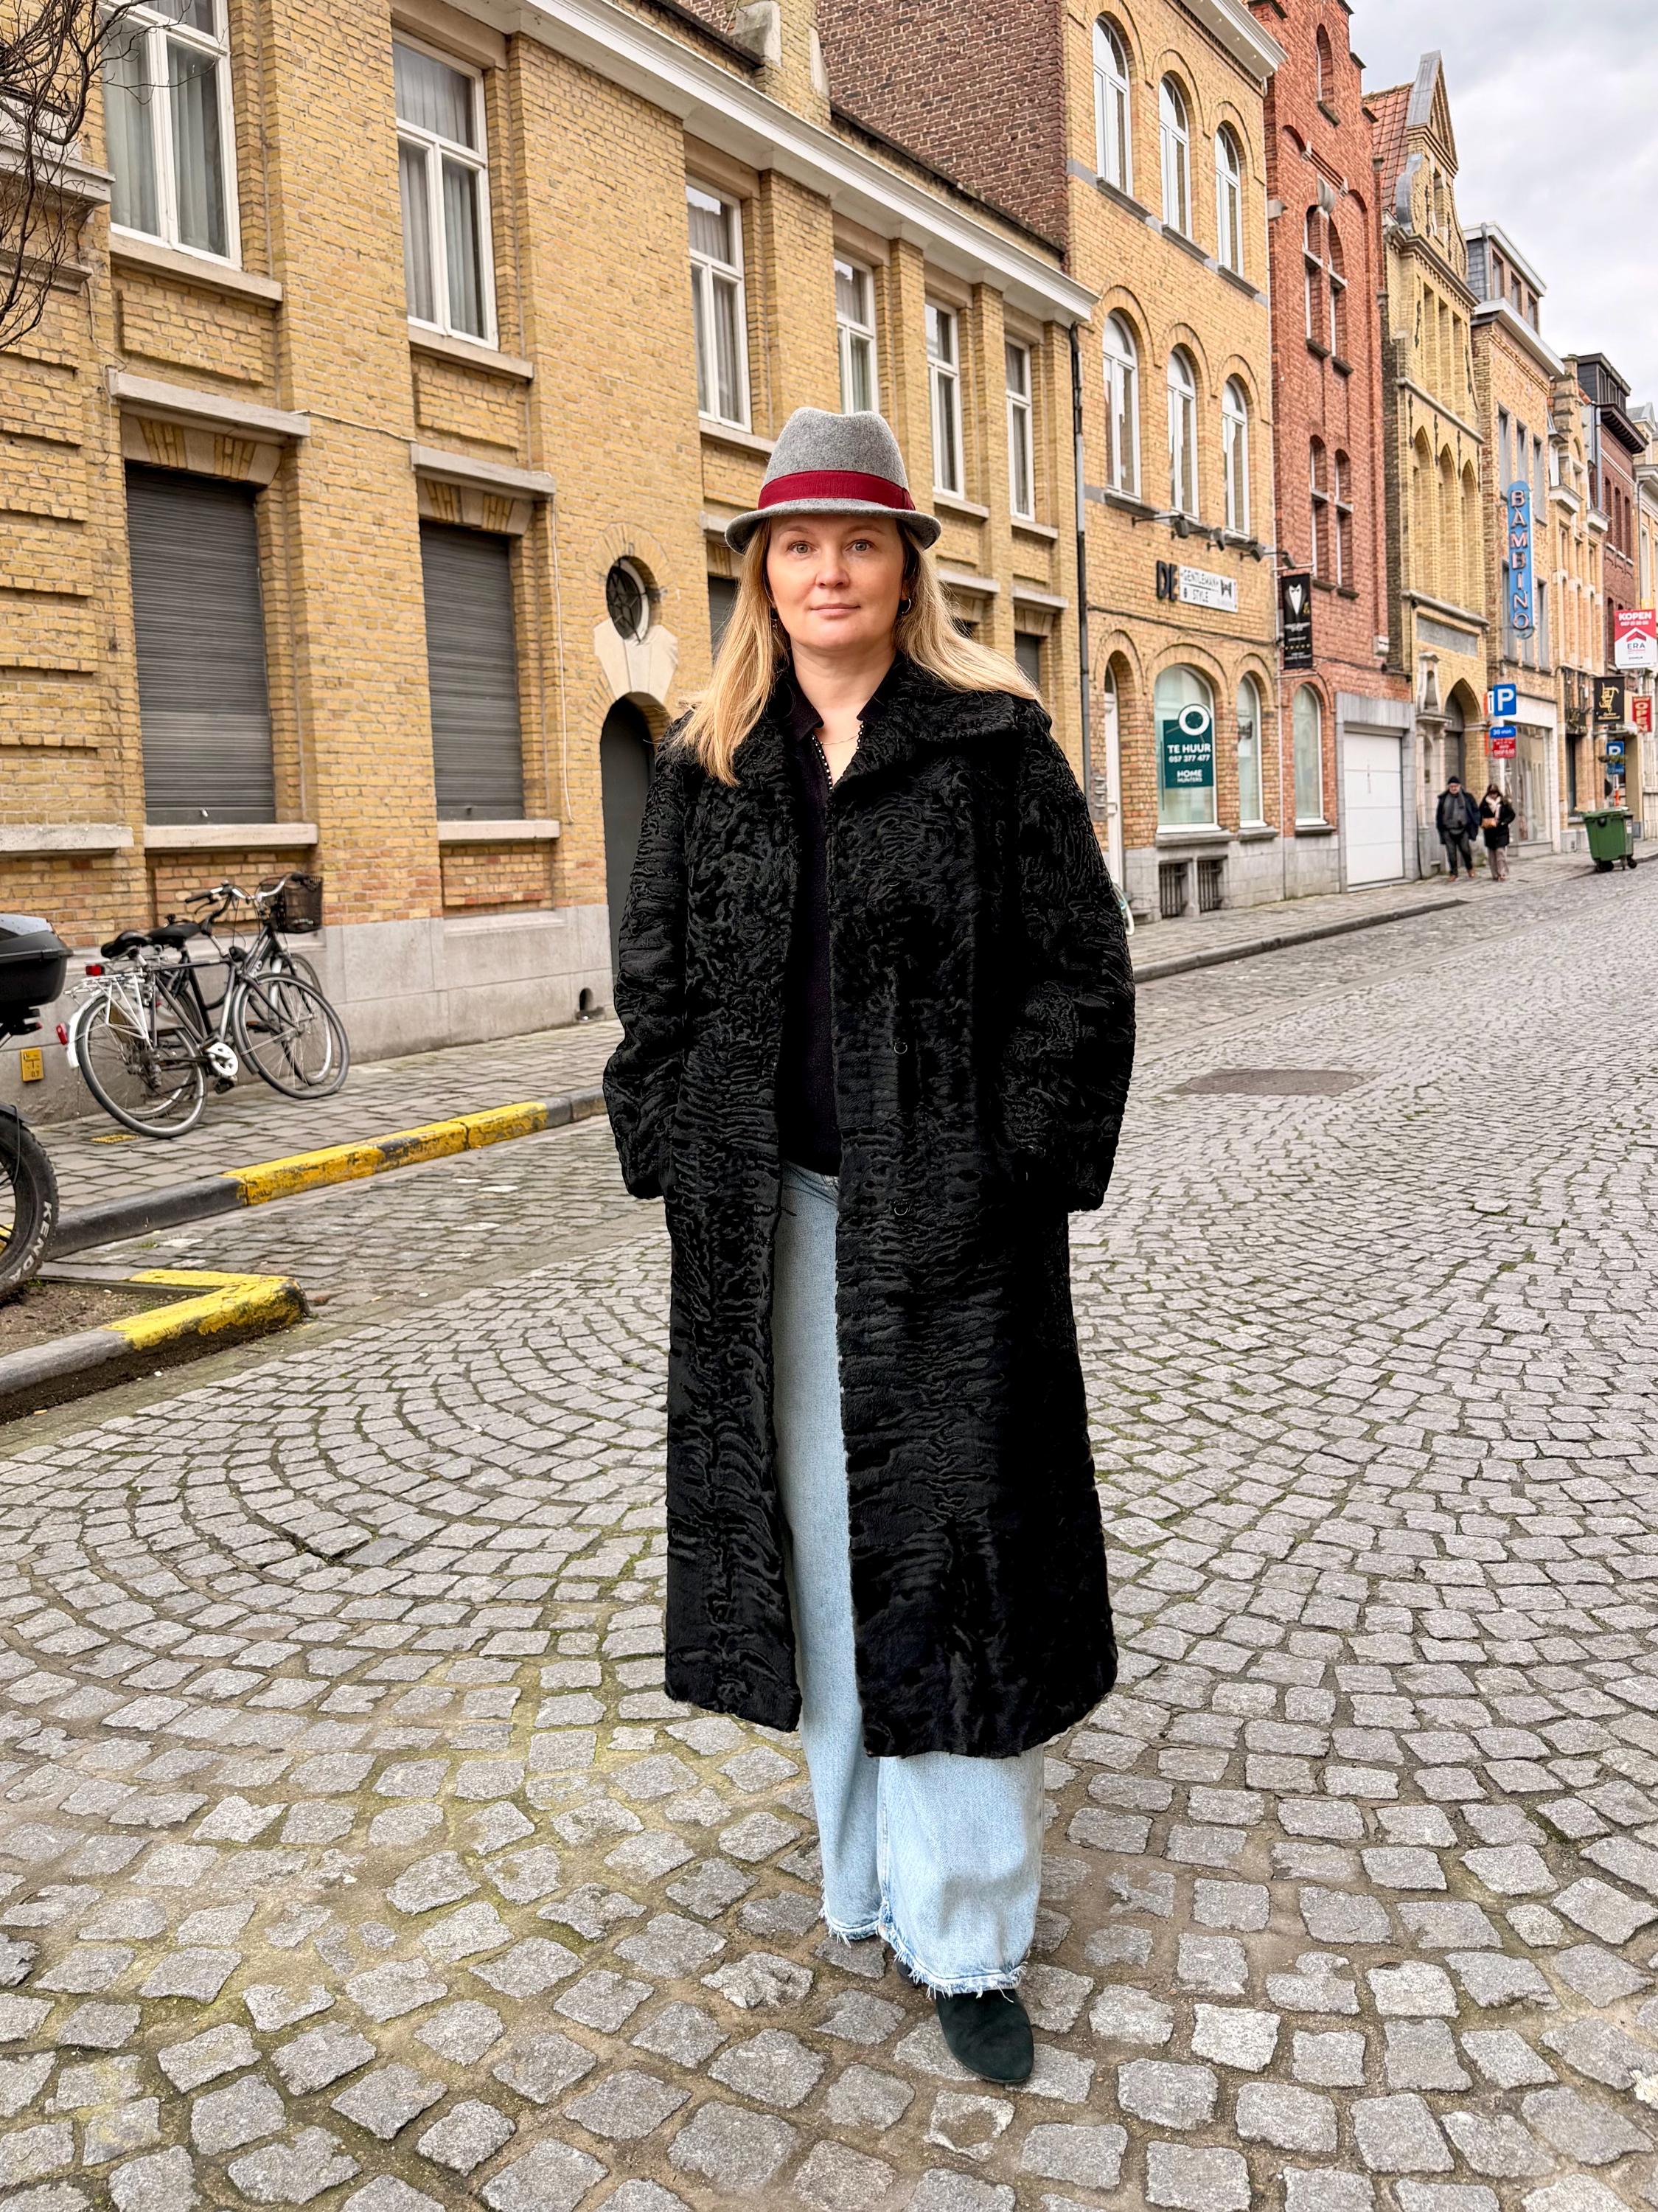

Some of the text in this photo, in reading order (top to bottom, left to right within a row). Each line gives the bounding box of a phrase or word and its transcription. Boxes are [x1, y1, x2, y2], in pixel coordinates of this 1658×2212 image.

[1511, 490, 1529, 630] BAMBINO
[1156, 560, 1177, 601] DE
[1619, 611, 1652, 621] KOPEN
[1497, 688, 1514, 712] P
[1634, 702, 1649, 732] OPEN
[1167, 743, 1211, 754] TE HUUR
[1177, 769, 1202, 777] HOME
[9, 1201, 52, 1281] KENDA
